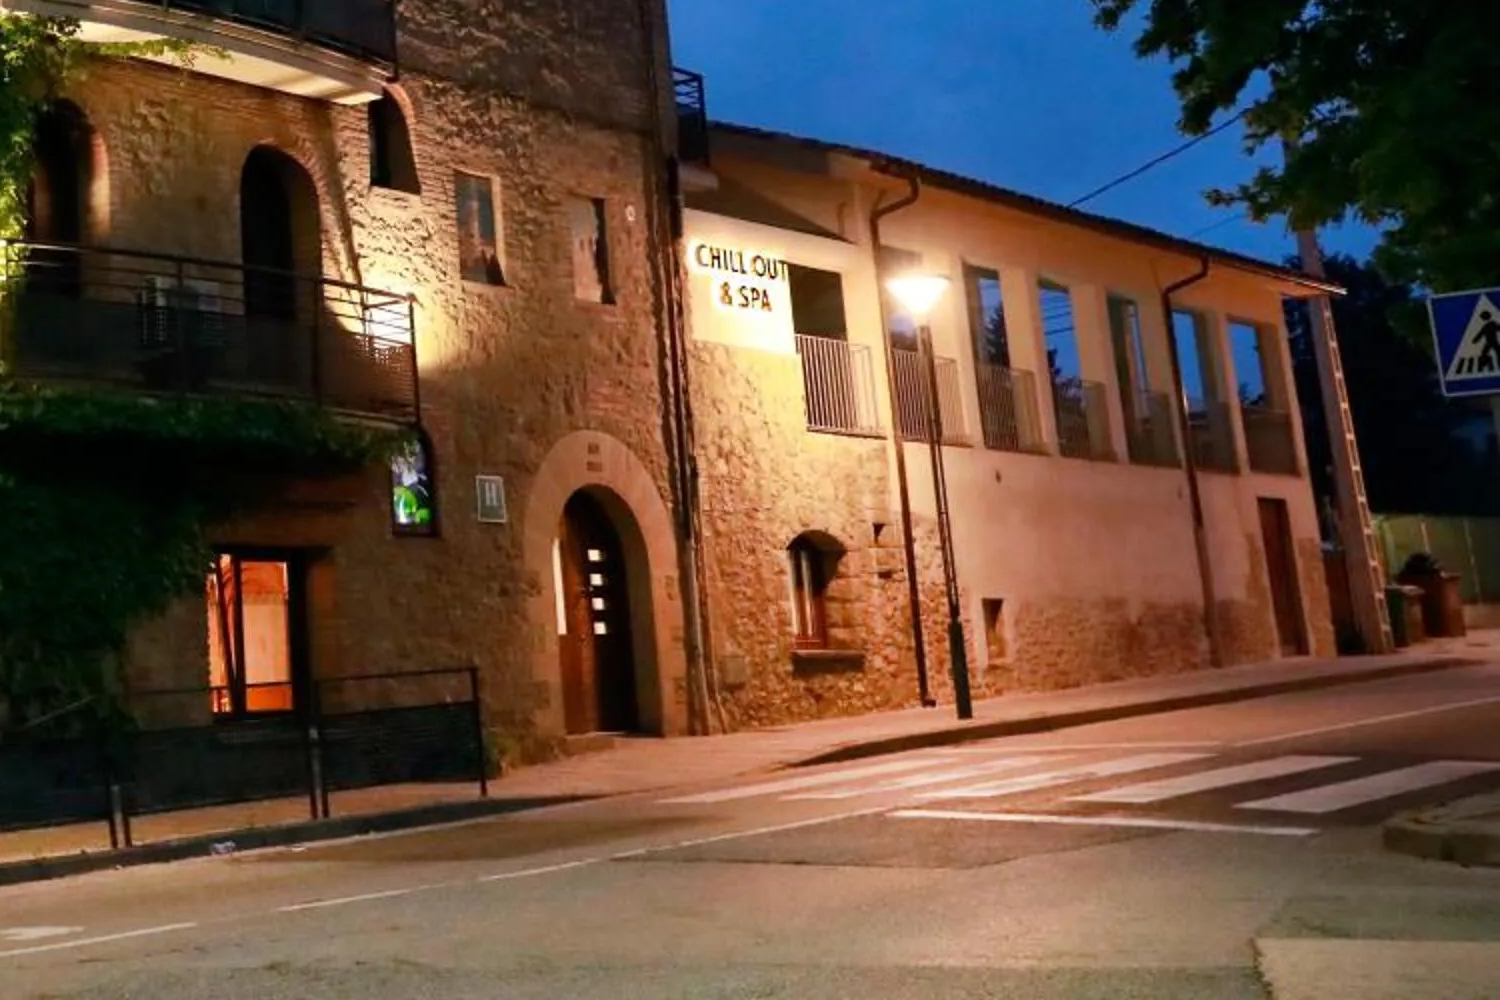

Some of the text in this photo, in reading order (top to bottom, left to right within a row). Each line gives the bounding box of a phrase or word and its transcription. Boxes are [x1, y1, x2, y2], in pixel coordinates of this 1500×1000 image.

[695, 244, 787, 281] CHILL OUT
[719, 281, 772, 312] & SPA
